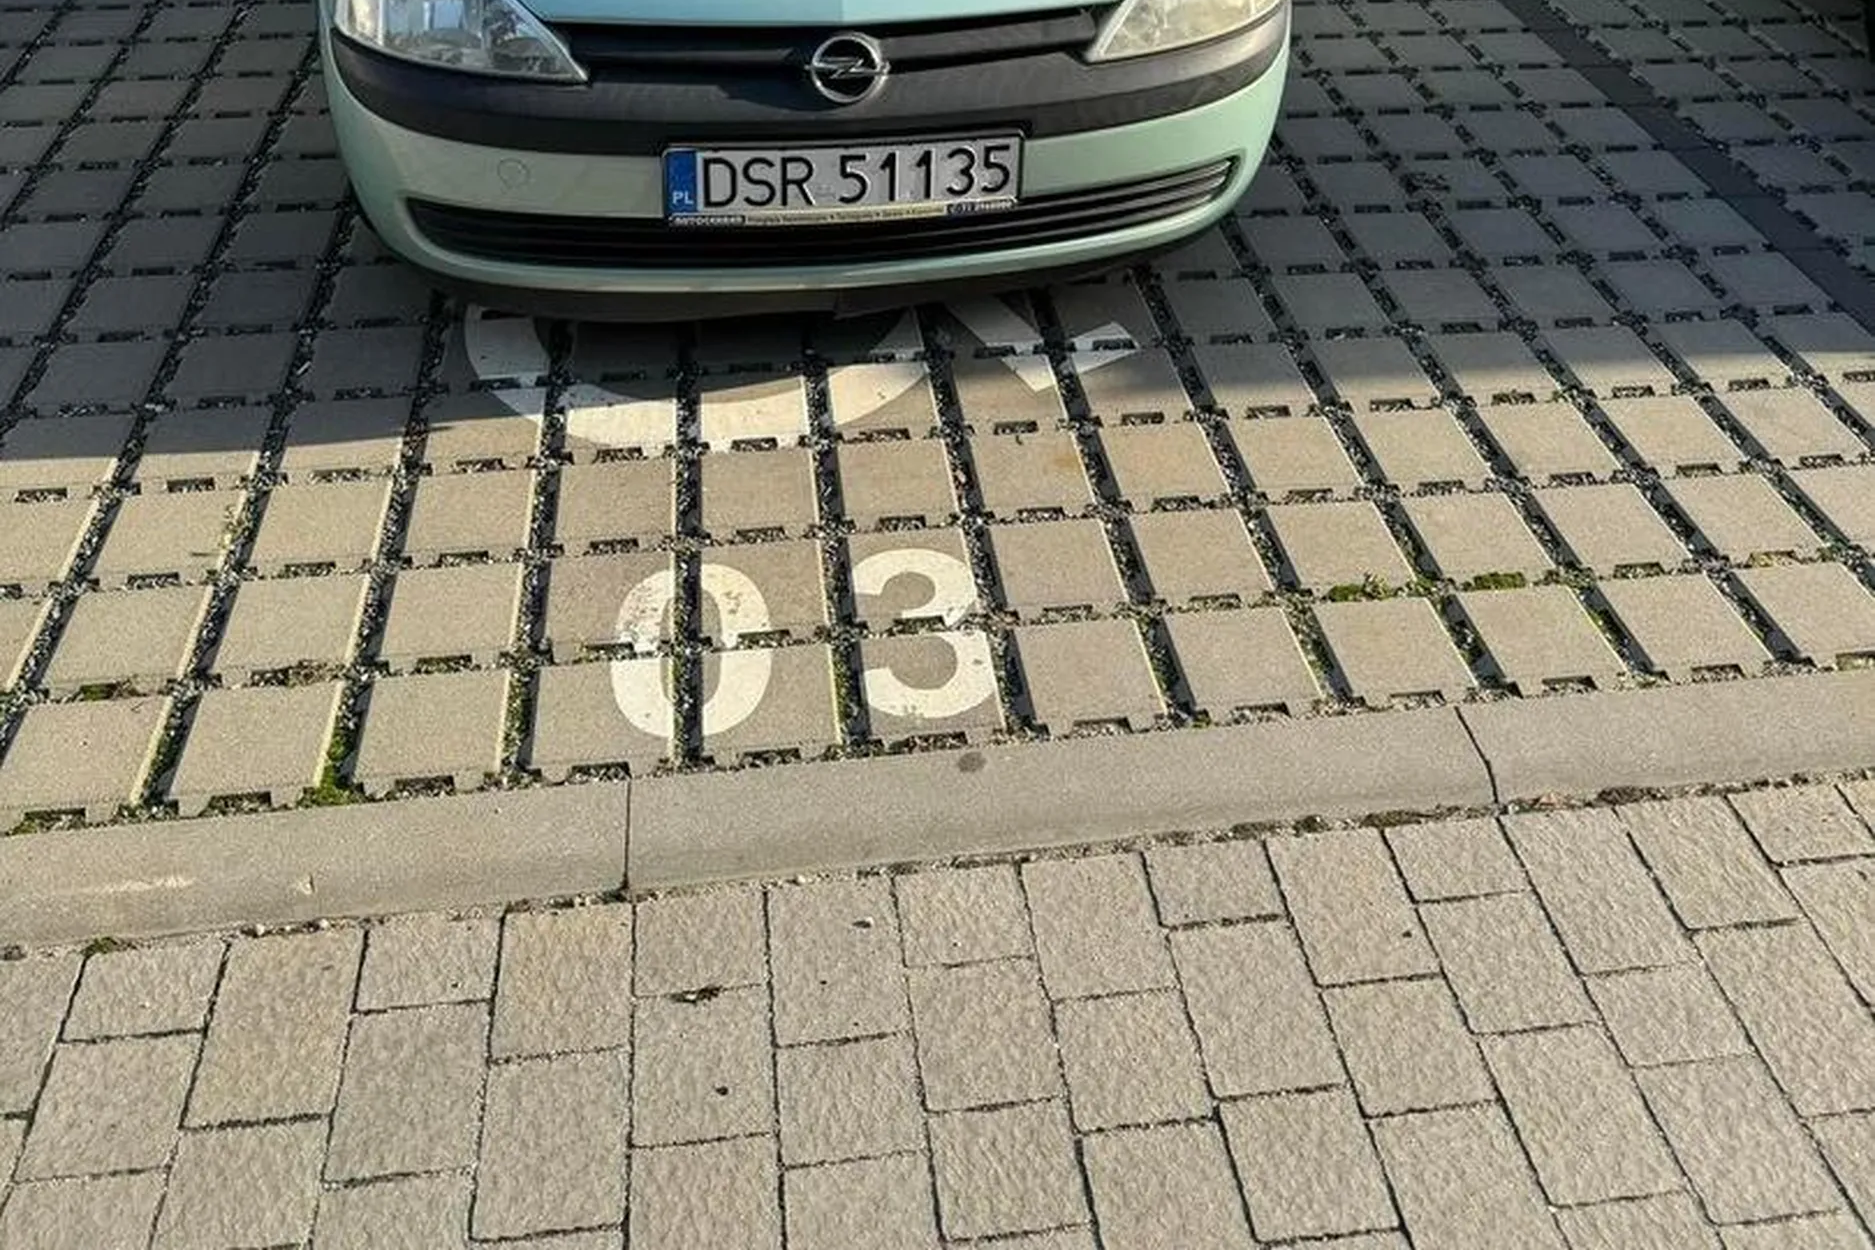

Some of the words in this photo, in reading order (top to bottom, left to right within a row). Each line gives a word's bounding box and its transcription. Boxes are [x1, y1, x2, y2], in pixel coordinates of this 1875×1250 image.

[672, 190, 695, 205] PL
[702, 155, 815, 207] DSR
[838, 145, 1011, 203] 51135
[610, 548, 1001, 737] 03
